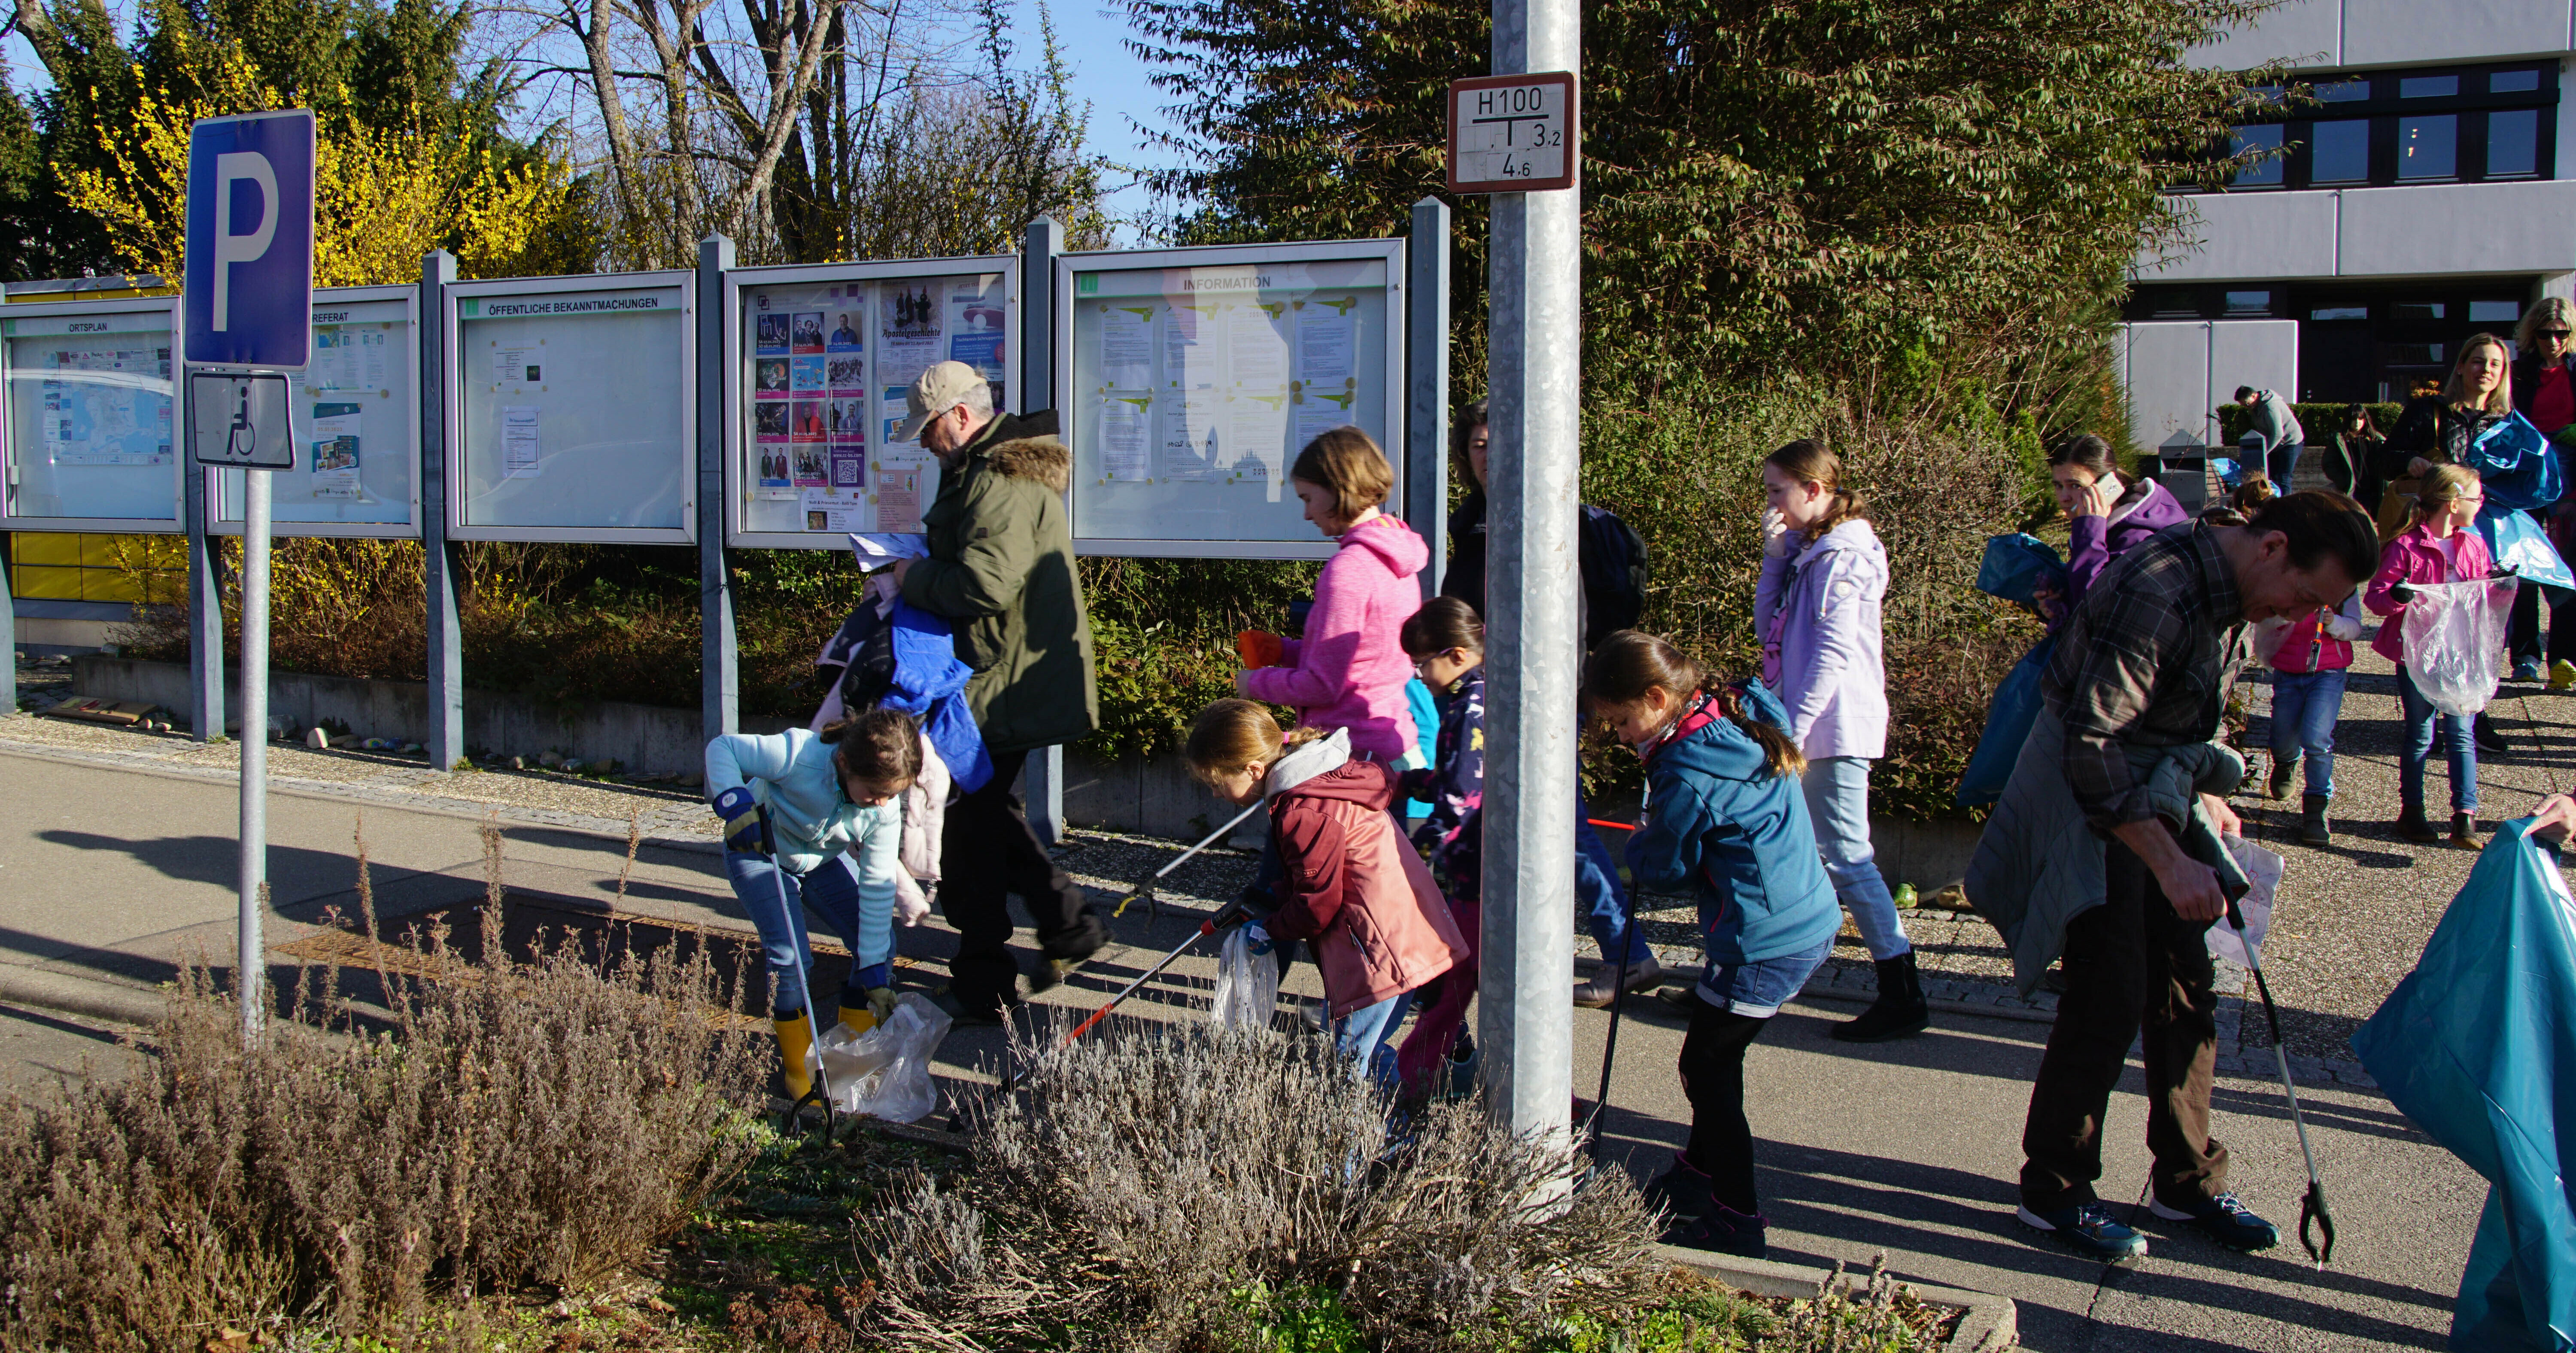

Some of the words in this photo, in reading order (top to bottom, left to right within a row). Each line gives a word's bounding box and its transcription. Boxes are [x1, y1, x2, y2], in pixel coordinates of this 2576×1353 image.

[1479, 87, 1542, 115] H100
[1533, 123, 1561, 147] 3,2
[1503, 153, 1531, 177] 4,6
[213, 152, 279, 332] P
[1184, 276, 1270, 290] INFORMATION
[489, 303, 551, 316] ÖFFENTLICHE
[554, 298, 658, 313] BEKANNTMACHUNGEN
[69, 322, 107, 332] ORTSPLAN
[882, 327, 941, 340] Apostelgeschichte
